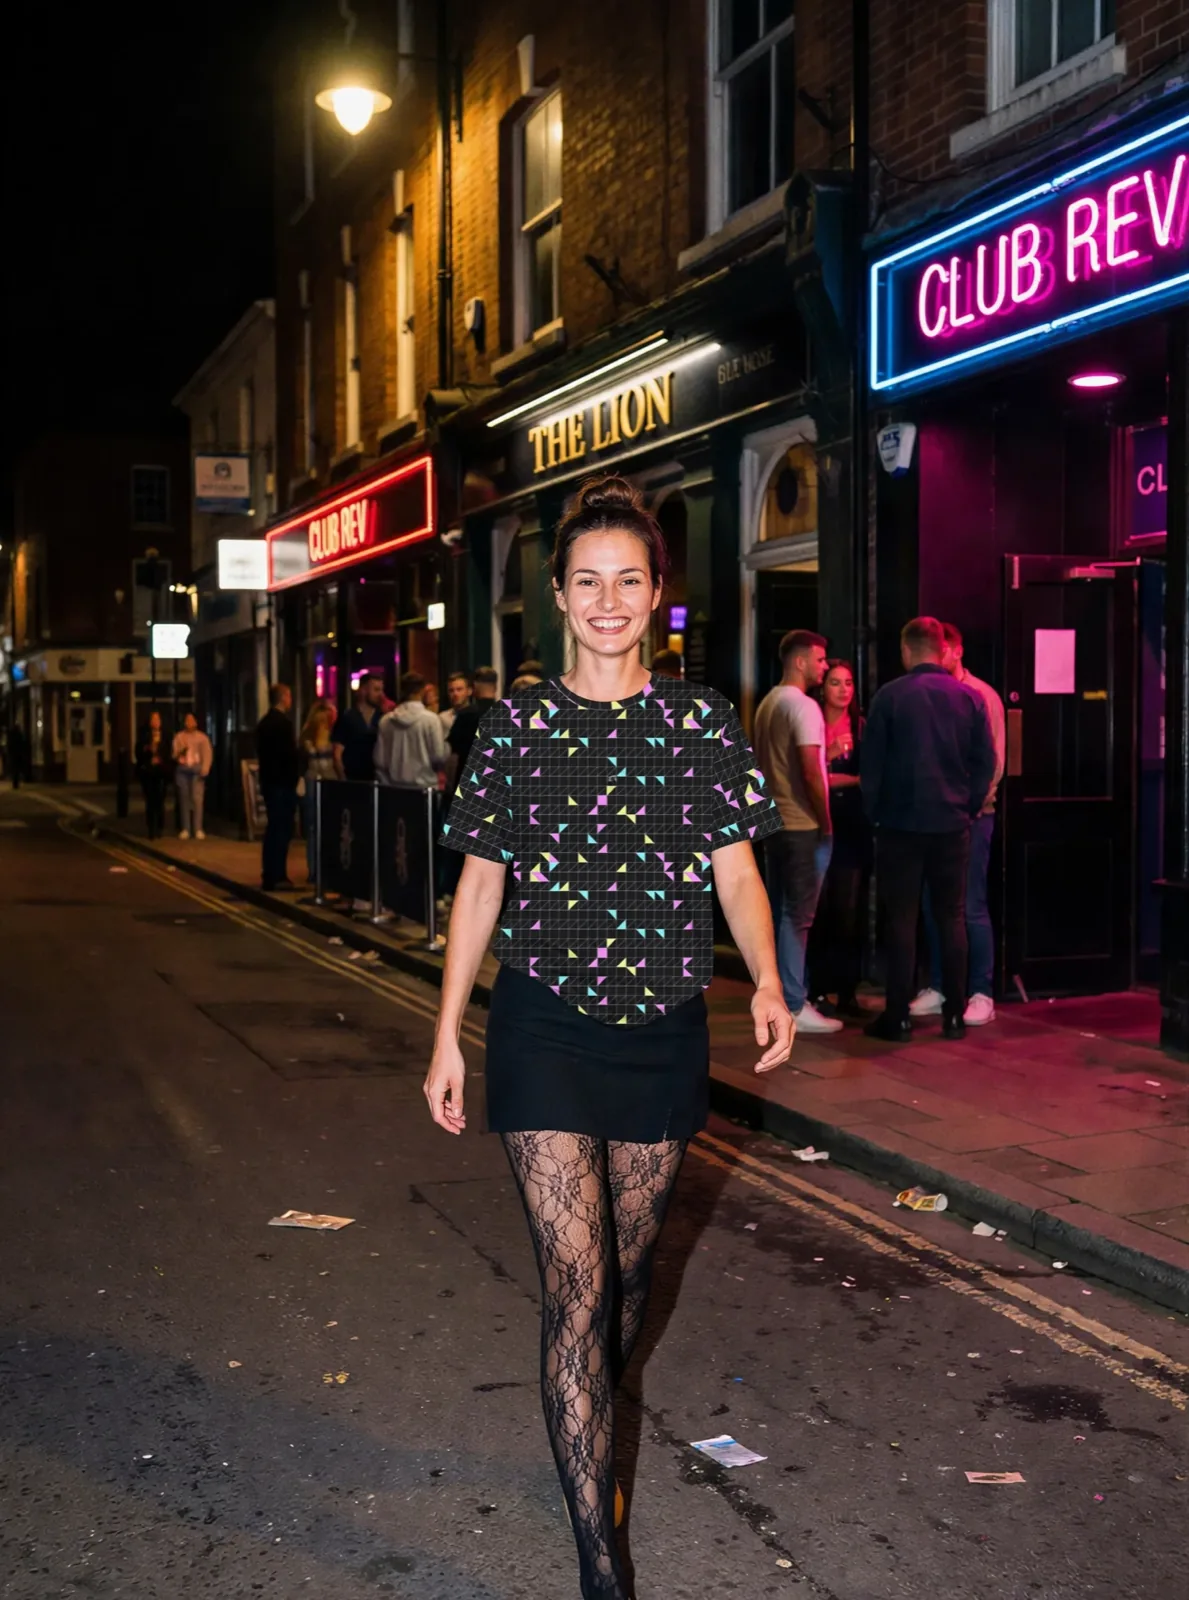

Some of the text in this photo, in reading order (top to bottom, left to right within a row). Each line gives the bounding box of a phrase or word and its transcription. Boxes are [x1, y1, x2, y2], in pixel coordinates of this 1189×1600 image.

[918, 155, 1187, 338] CLUB REV
[528, 372, 675, 474] THE LION
[1136, 463, 1169, 496] CL
[308, 498, 369, 562] CLUB REV
